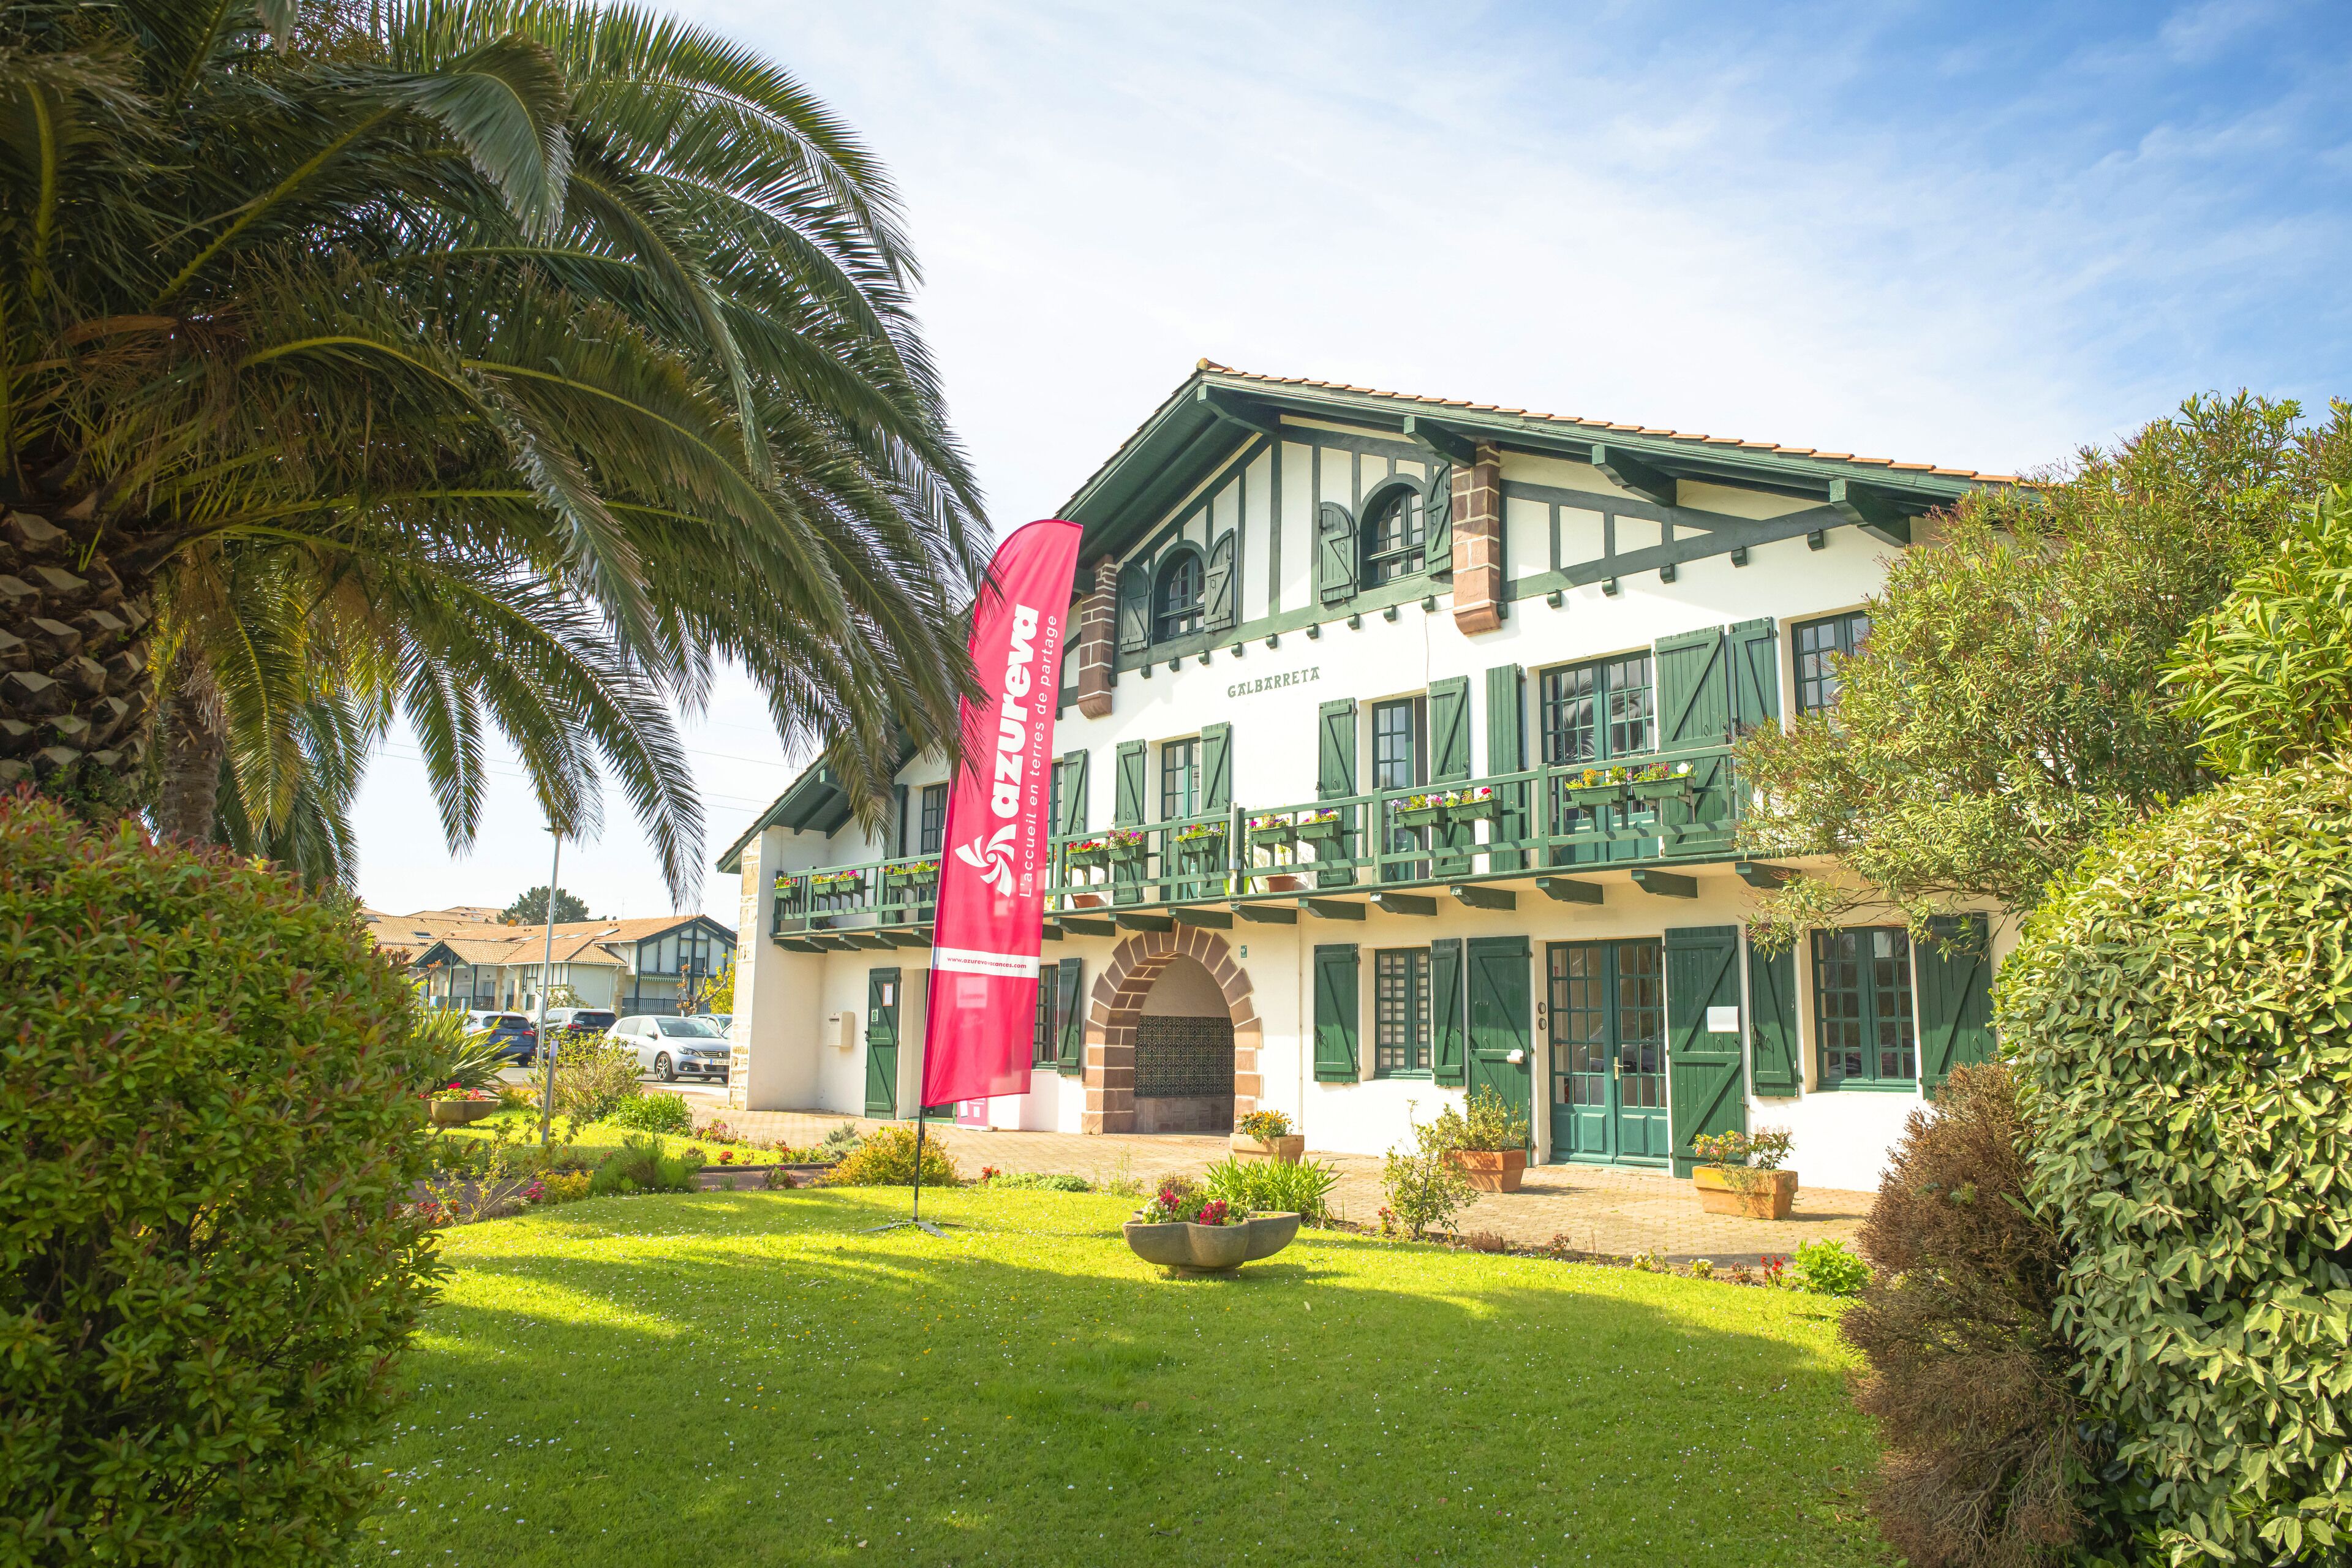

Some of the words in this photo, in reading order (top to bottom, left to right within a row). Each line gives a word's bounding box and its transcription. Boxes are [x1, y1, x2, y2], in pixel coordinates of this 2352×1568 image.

[1041, 616, 1058, 687] partage
[1035, 693, 1047, 715] de
[1227, 666, 1320, 698] GALBARRETA
[991, 604, 1039, 818] azureva
[1030, 723, 1044, 776] terres
[1030, 785, 1038, 806] en
[1019, 813, 1036, 897] L'accueil
